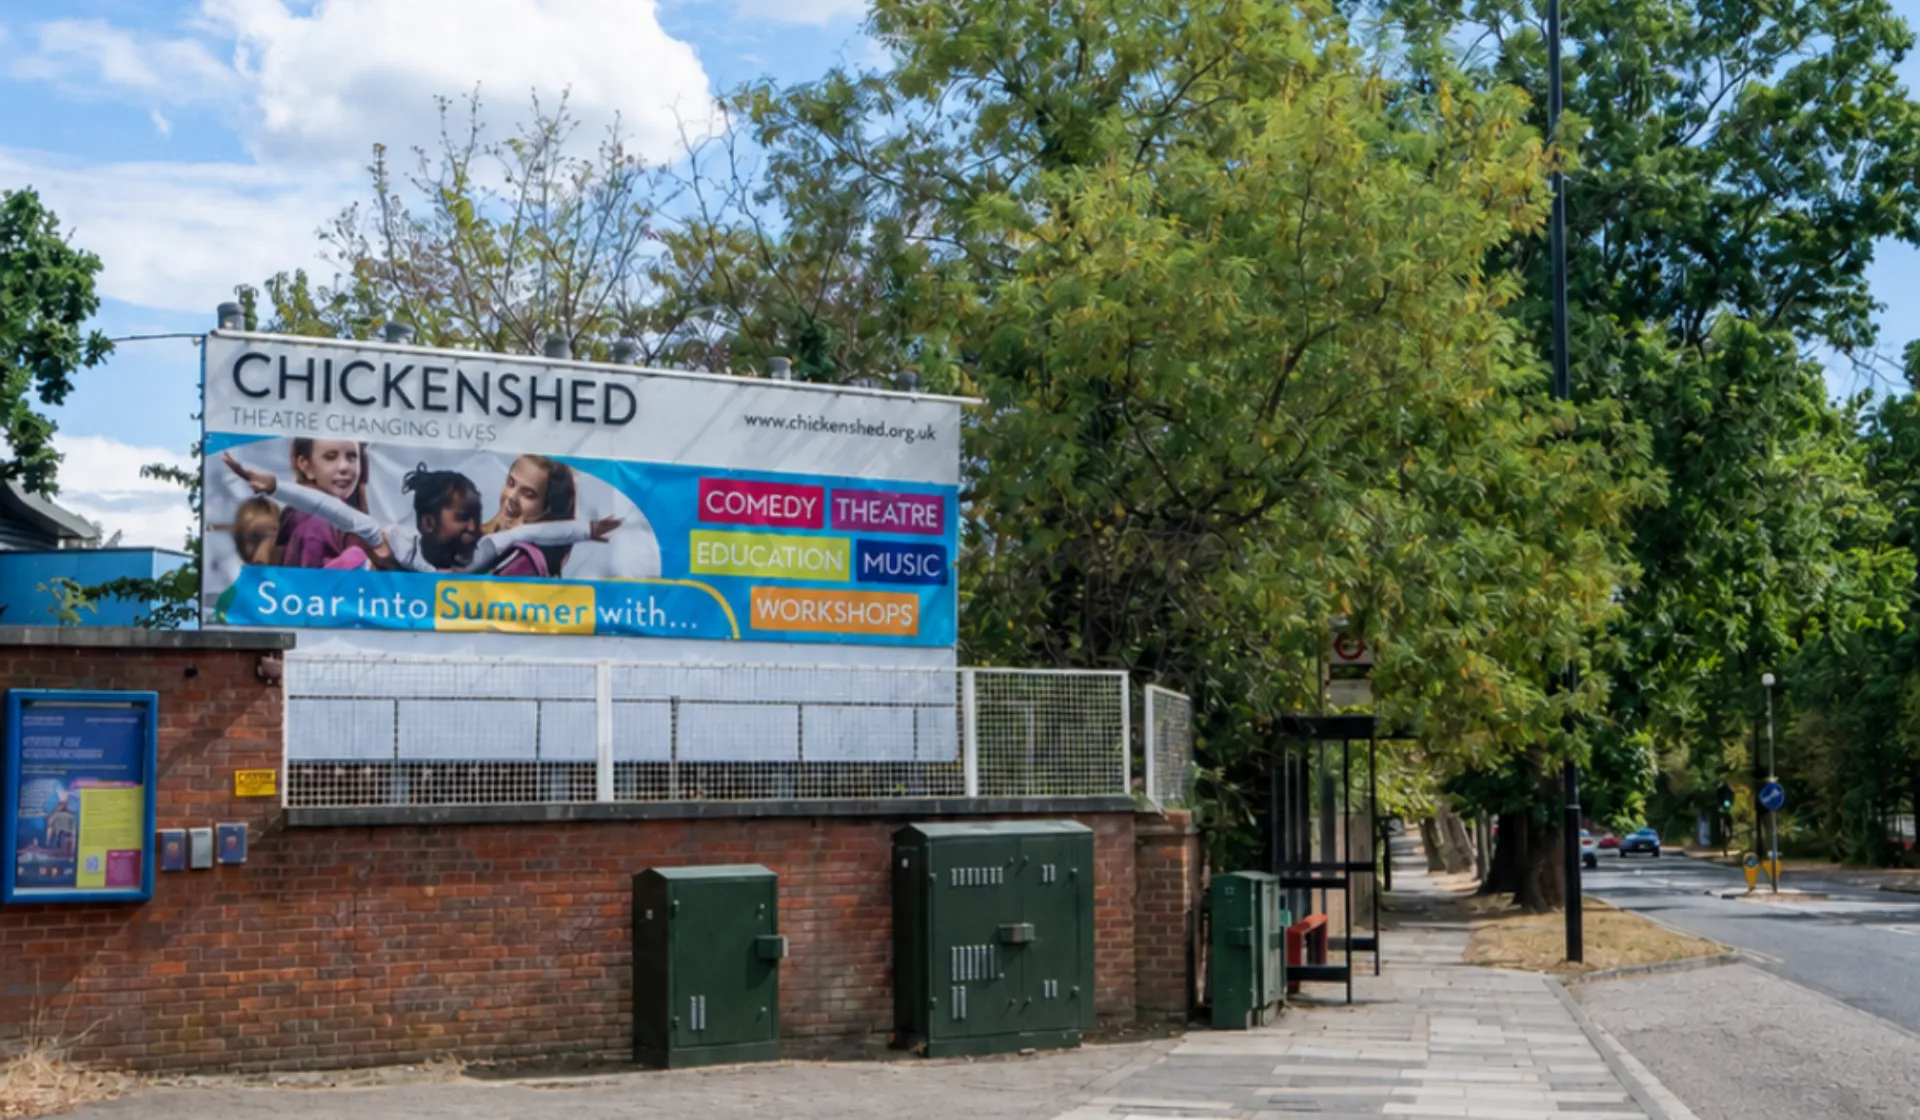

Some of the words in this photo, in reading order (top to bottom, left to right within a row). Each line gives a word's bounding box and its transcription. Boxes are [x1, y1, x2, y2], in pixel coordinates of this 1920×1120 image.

[232, 352, 638, 426] CHICKENSHED
[231, 406, 319, 431] THEATRE
[325, 413, 441, 439] CHANGING
[448, 422, 497, 442] LIVES
[743, 413, 937, 444] www.chickenshed.org.uk
[706, 490, 817, 520] COMEDY
[834, 497, 939, 528] THEATRE
[696, 541, 843, 572] EDUCATION
[863, 552, 941, 577] MUSIC
[257, 580, 345, 617] Soar
[357, 586, 429, 619] into
[440, 585, 590, 625] Summer
[598, 595, 699, 629] with...
[755, 597, 914, 627] WORKSHOPS
